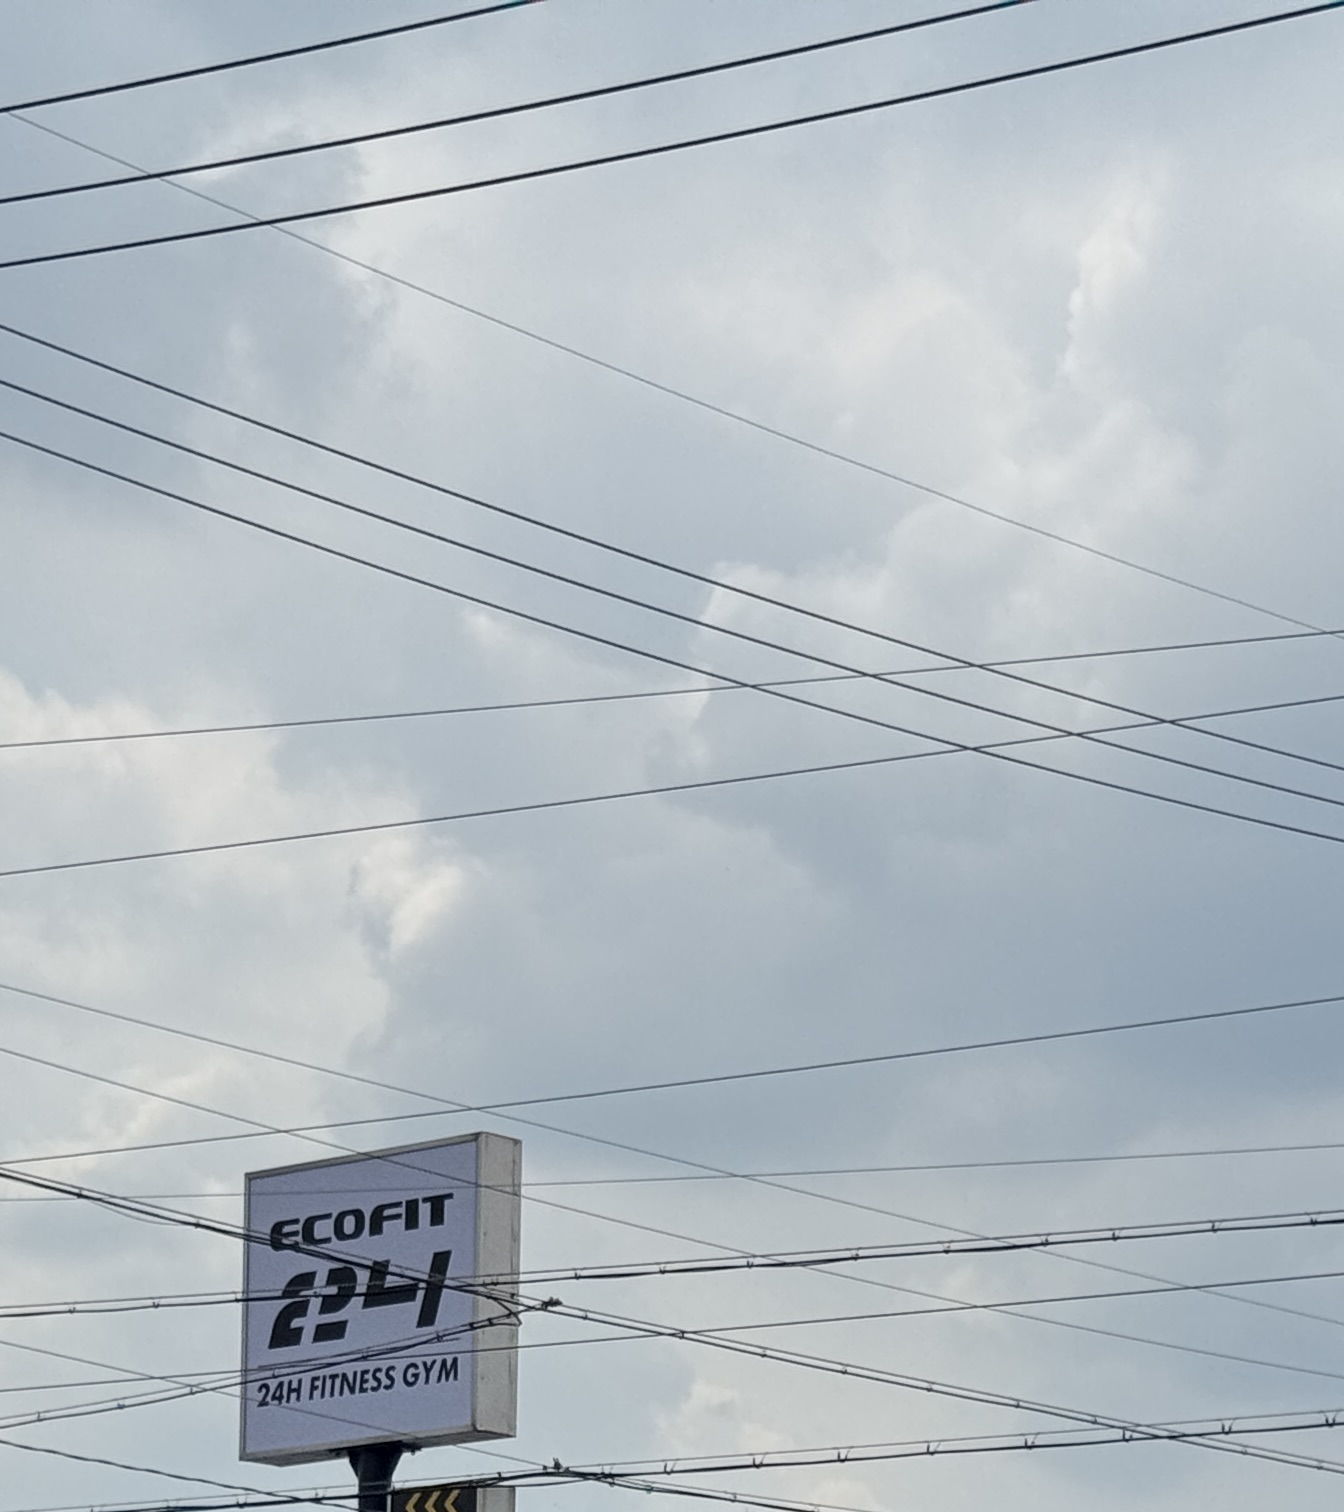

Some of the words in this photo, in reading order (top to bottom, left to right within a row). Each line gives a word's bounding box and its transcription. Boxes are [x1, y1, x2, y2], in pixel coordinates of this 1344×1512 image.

[270, 1193, 454, 1252] ECOFIT
[268, 1250, 452, 1349] 24
[257, 1379, 303, 1408] 24H
[308, 1365, 397, 1402] FITNESS
[402, 1356, 459, 1388] GYM
